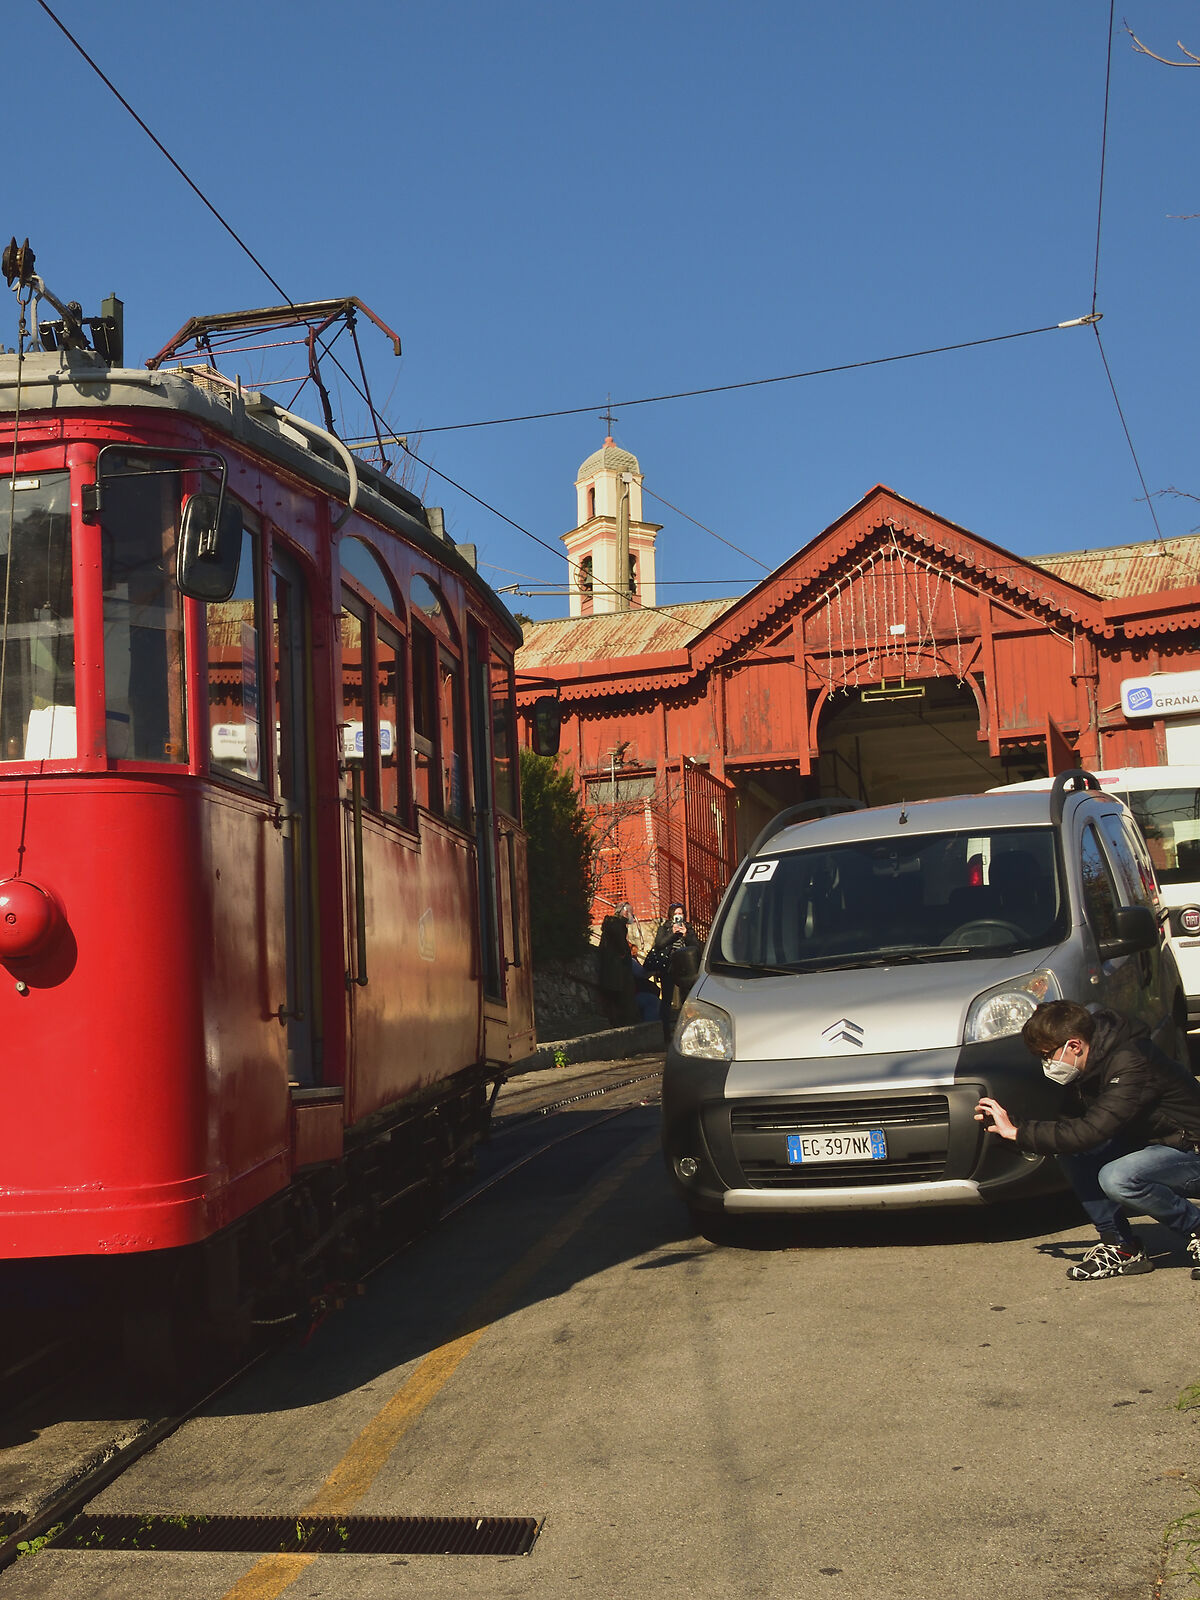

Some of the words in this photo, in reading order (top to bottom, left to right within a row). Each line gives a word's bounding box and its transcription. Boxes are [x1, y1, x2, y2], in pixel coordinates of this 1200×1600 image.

[1155, 695, 1199, 707] GRANA
[749, 864, 771, 880] P
[1185, 915, 1199, 926] FIAT
